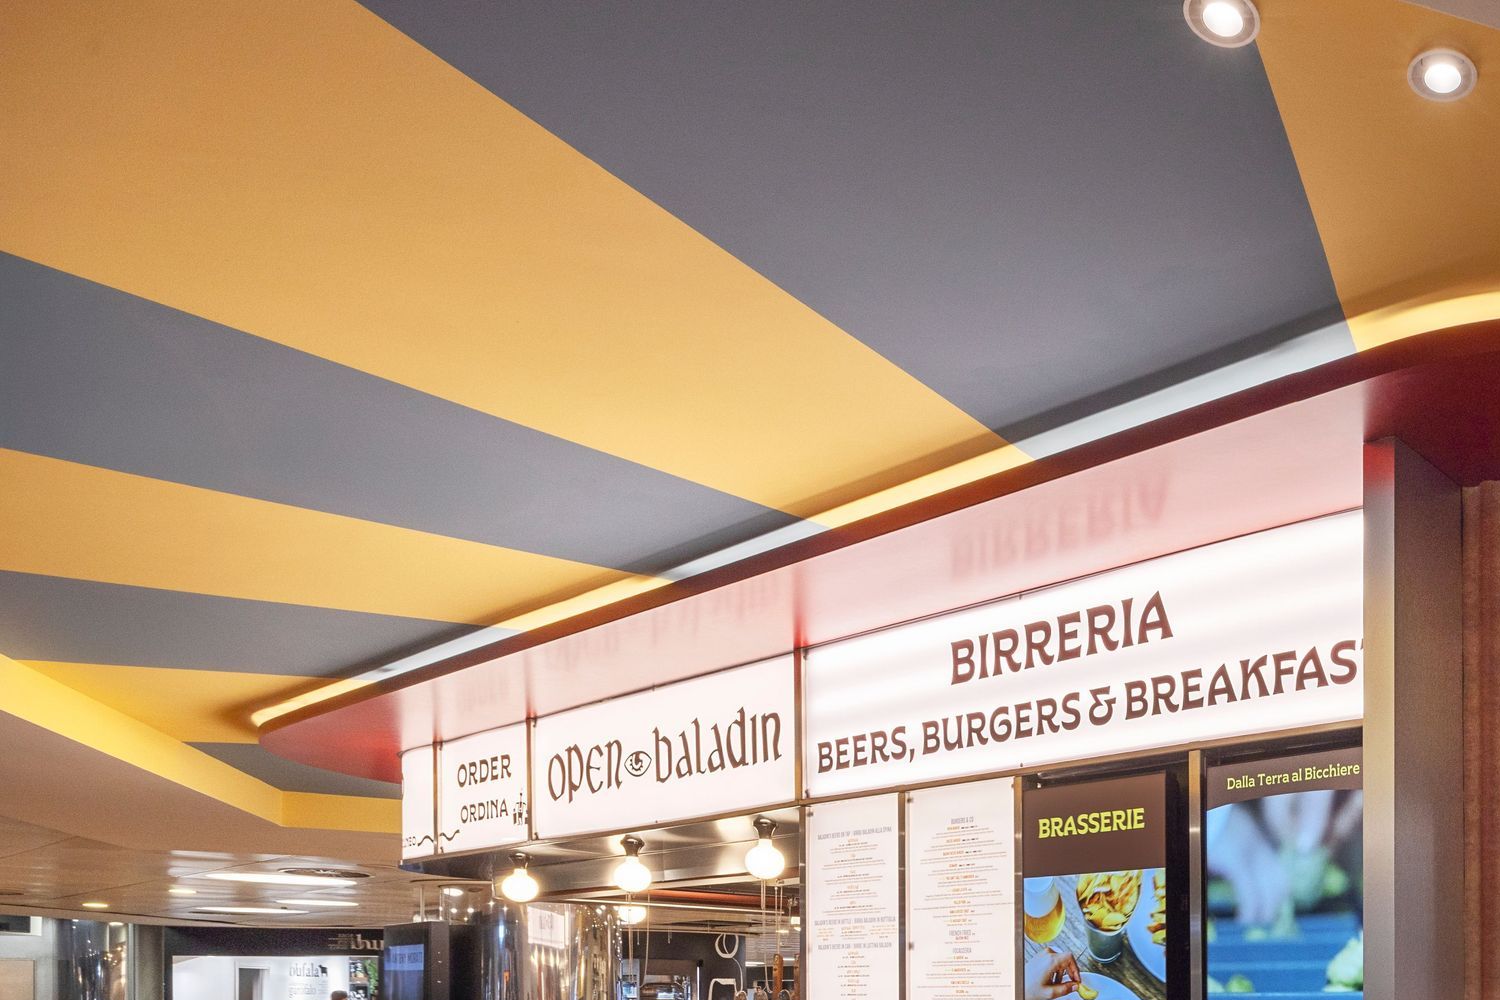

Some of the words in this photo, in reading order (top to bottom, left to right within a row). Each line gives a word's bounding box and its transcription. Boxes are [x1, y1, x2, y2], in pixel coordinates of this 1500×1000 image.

[950, 590, 1174, 685] BIRRERIA
[817, 725, 915, 773] BEERS,
[921, 692, 1082, 755] BURGERS
[1088, 685, 1117, 726] &
[1123, 638, 1364, 721] BREAKFAS
[652, 706, 782, 783] baladin
[457, 754, 512, 788] ORDER
[1226, 776, 1256, 790] Dalla
[1257, 772, 1290, 786] Terra
[1291, 768, 1302, 782] al
[1304, 763, 1360, 780] Bicchiere
[460, 798, 509, 824] ORDINA
[1038, 807, 1145, 839] BRASSERIE
